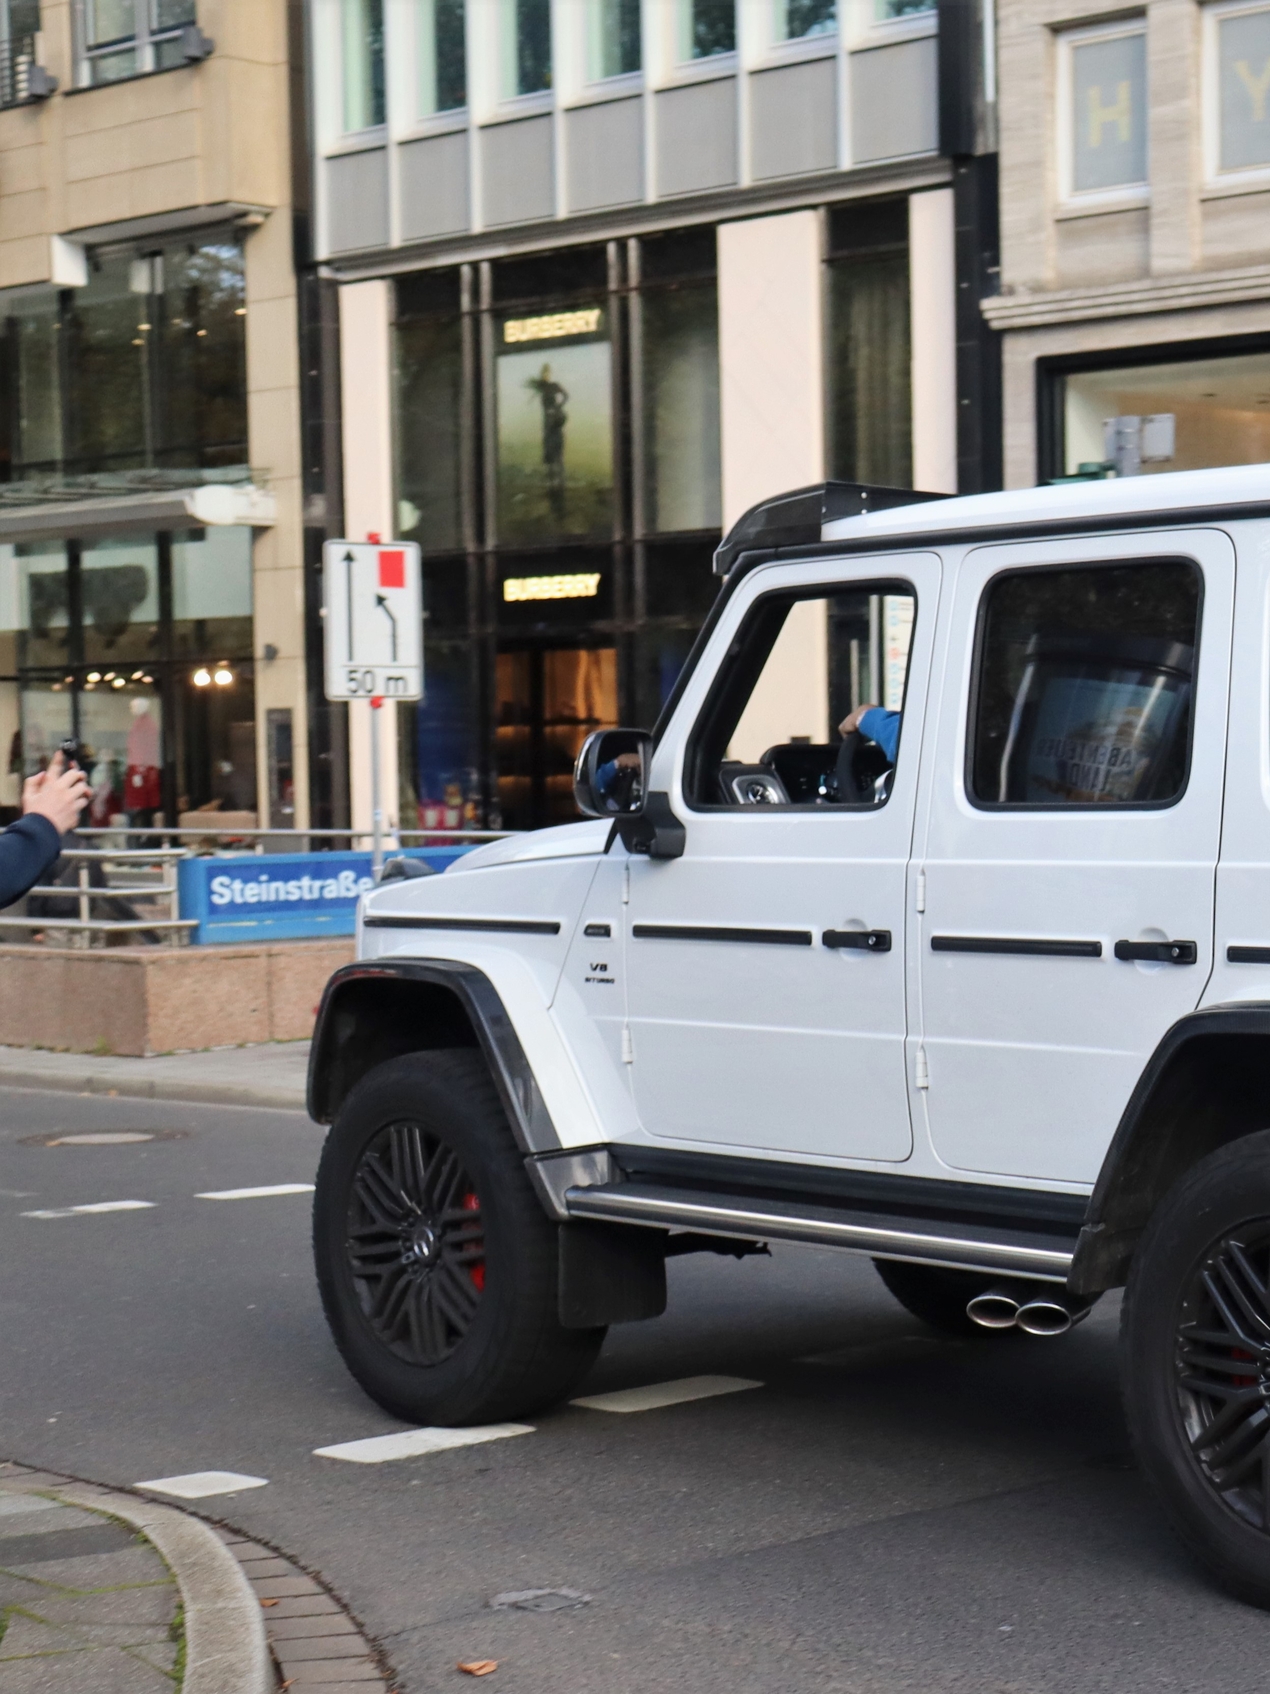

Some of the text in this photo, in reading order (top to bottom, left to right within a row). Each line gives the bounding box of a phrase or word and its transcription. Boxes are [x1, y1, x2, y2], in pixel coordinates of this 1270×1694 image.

[504, 308, 601, 343] BURBERRY
[503, 573, 601, 602] BURBERRY
[346, 669, 409, 694] 50 m
[210, 869, 374, 905] Steinstraße
[589, 962, 608, 973] V8
